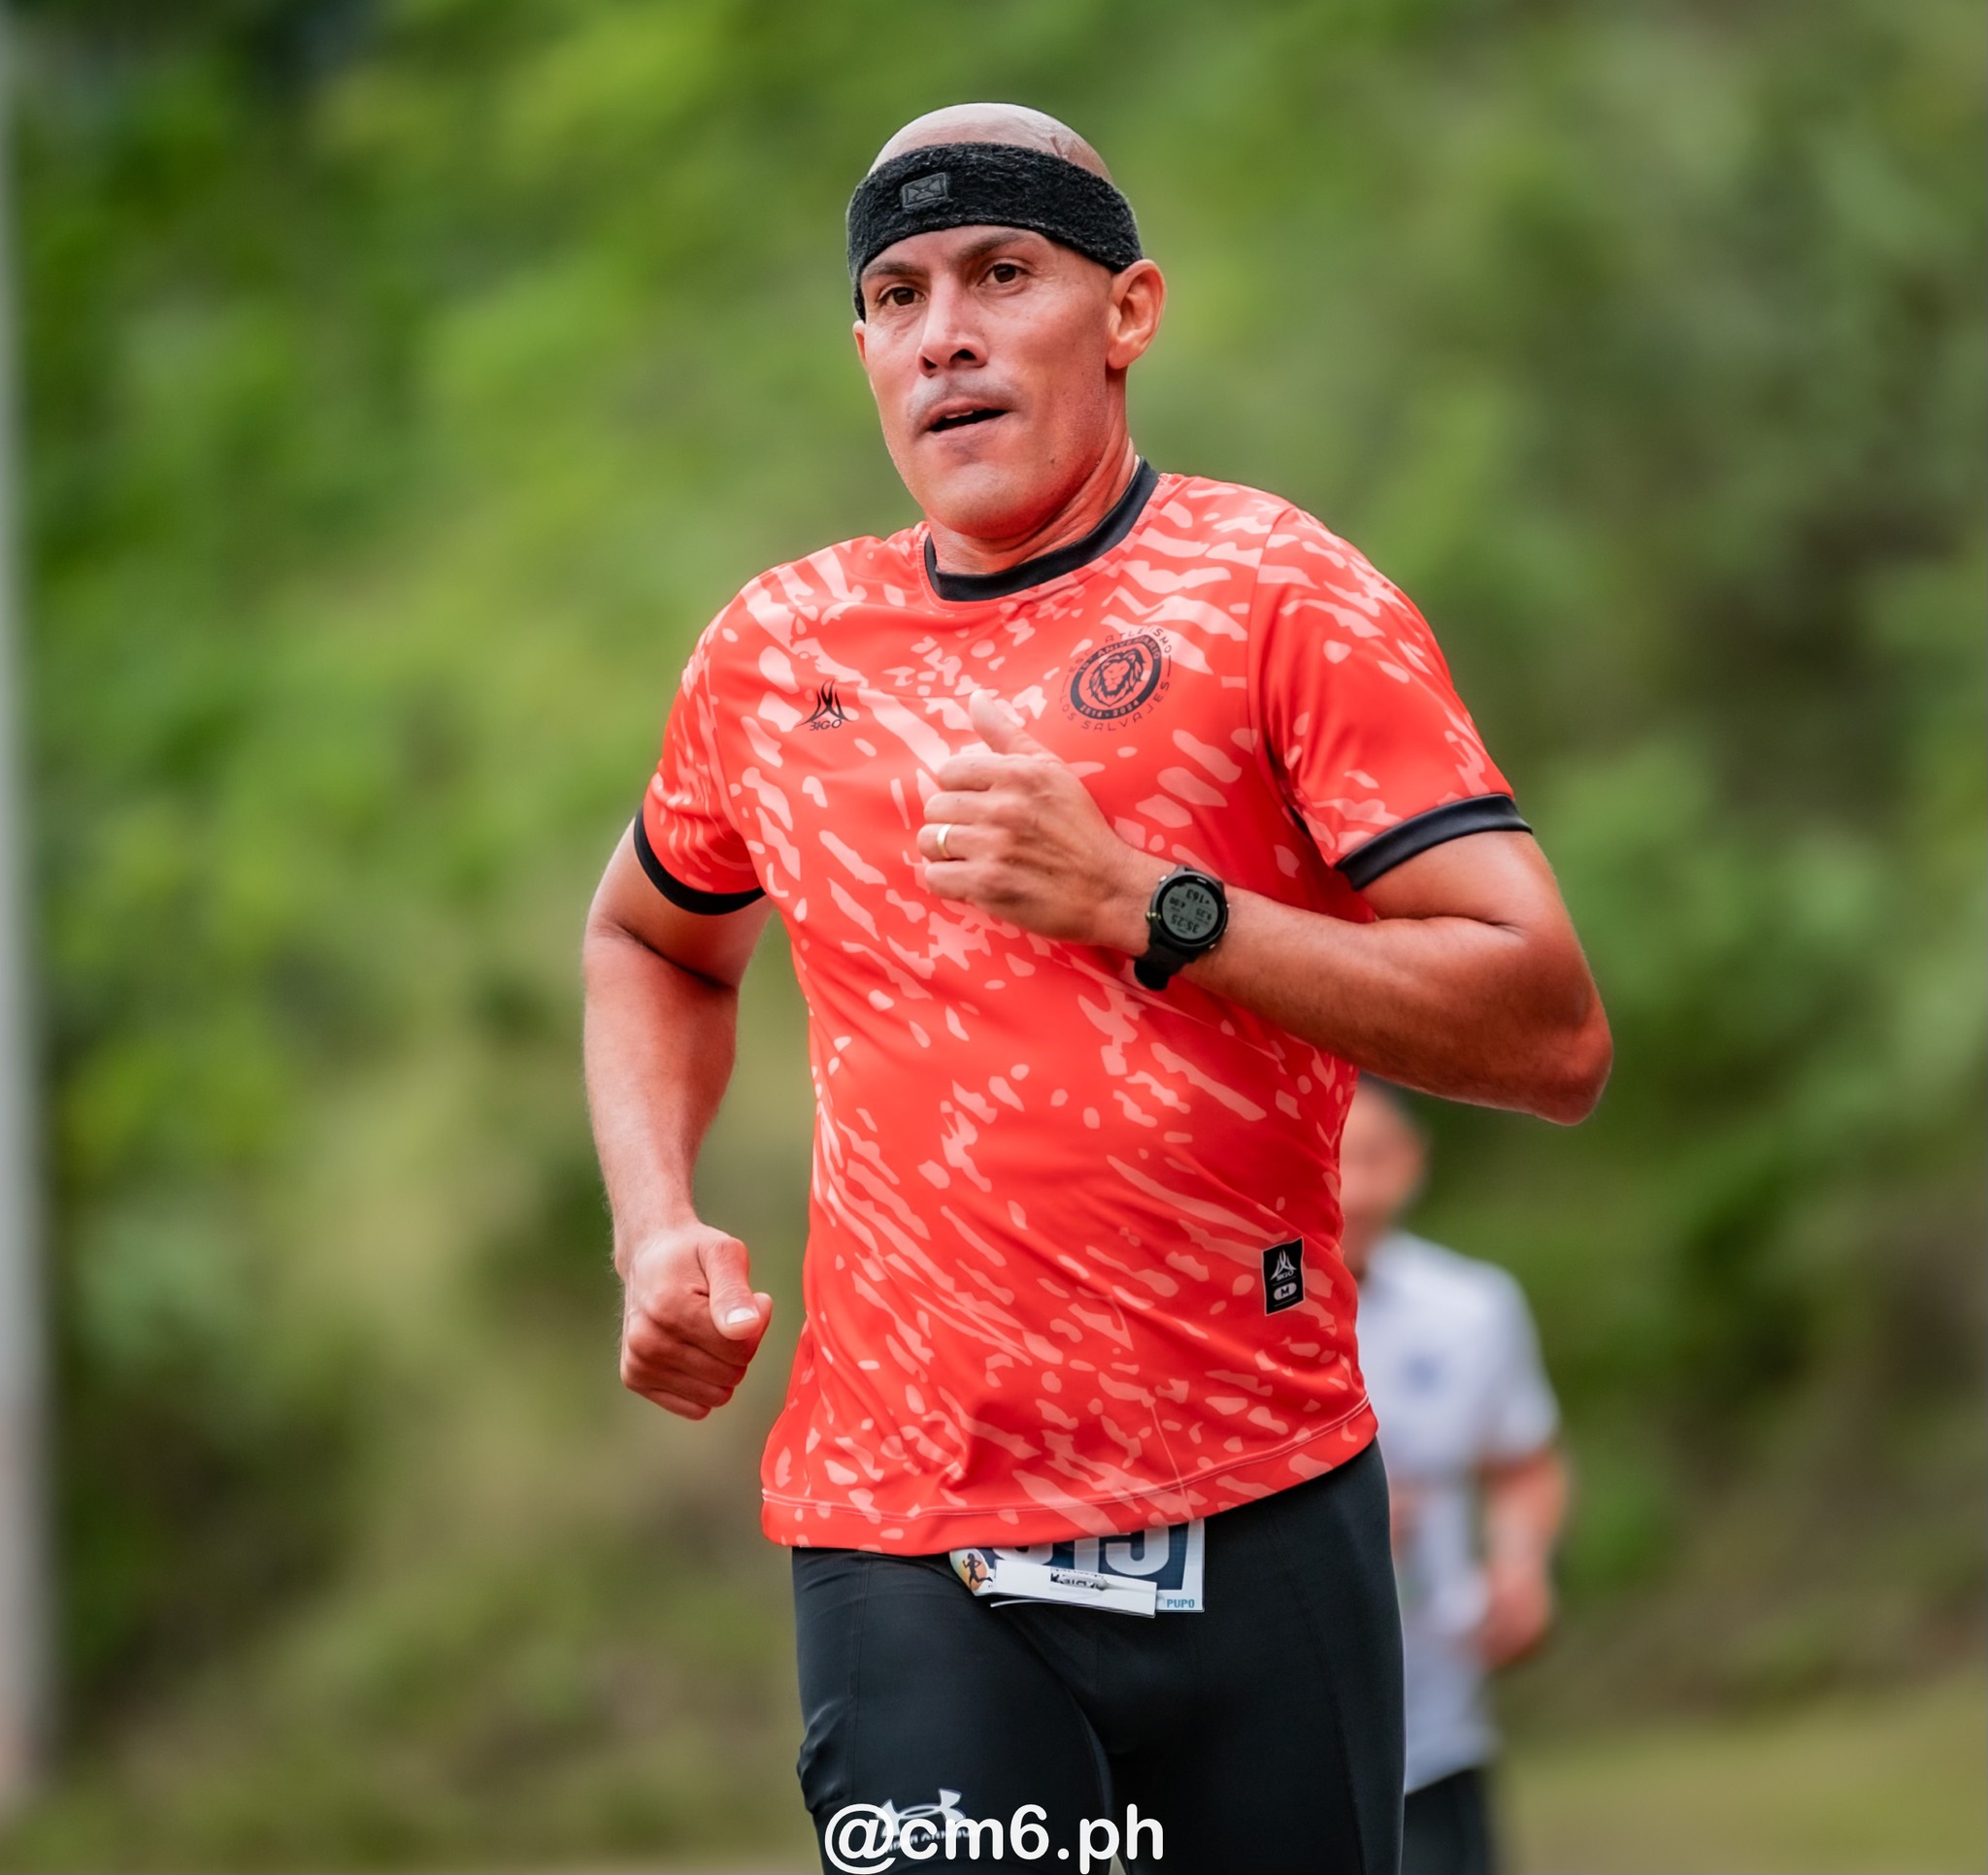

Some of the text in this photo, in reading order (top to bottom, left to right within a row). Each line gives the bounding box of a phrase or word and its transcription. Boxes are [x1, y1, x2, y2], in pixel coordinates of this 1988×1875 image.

[1081, 682, 1170, 731] SALVAJES
[1281, 1286, 1289, 1297] M
[1167, 1598, 1195, 1609] PUPO
